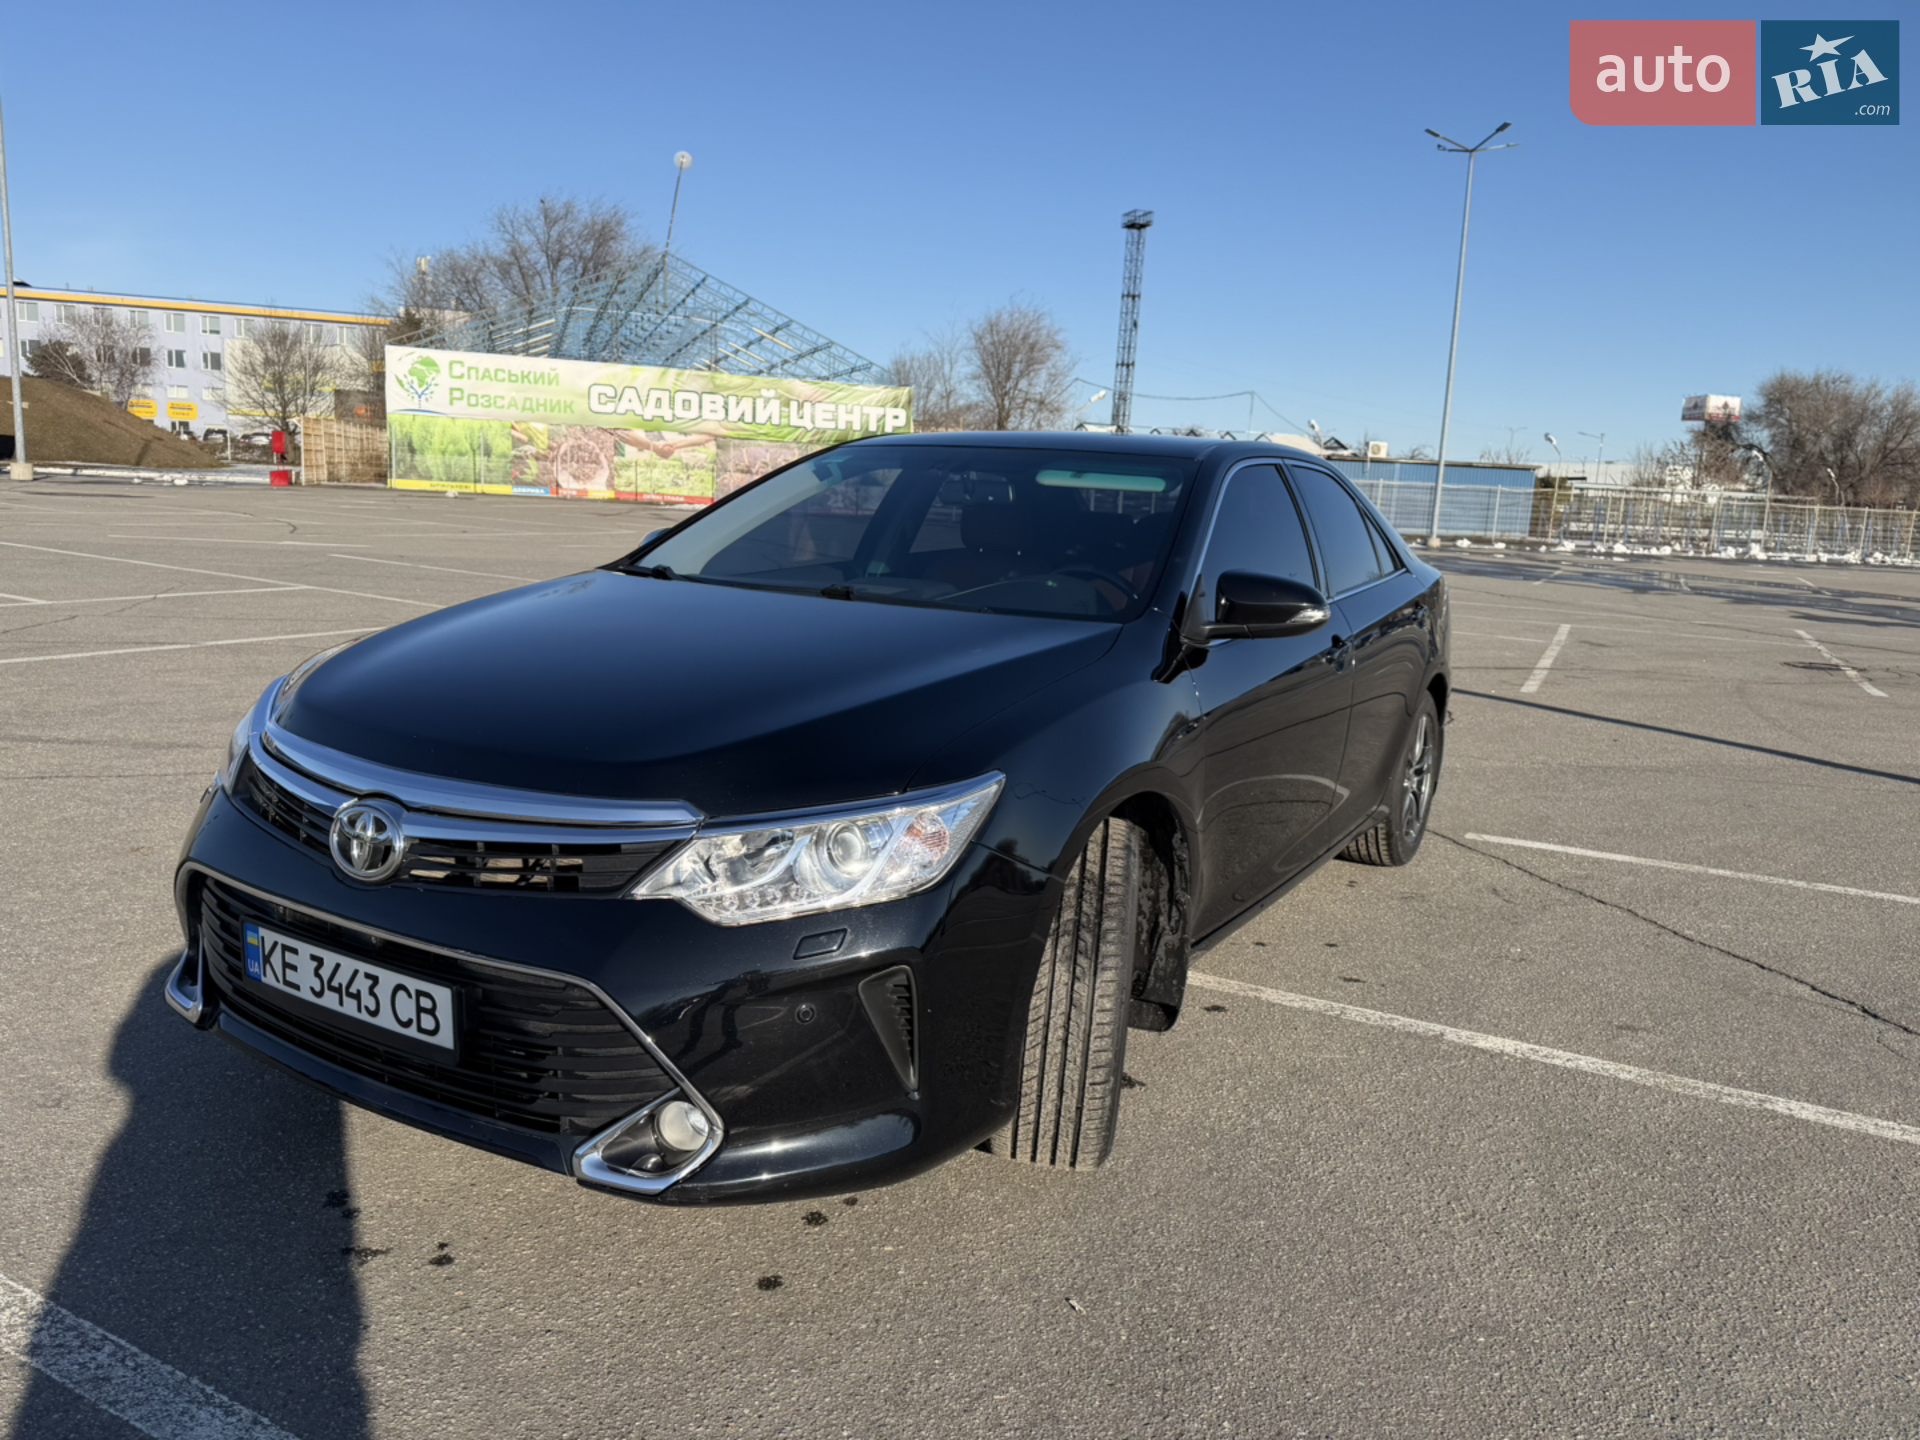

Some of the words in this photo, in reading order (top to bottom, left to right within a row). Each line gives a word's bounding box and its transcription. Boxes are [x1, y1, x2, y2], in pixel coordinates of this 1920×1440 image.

[588, 383, 781, 426] САДОВИЙ
[788, 400, 907, 433] ЦЕНТР
[247, 958, 261, 974] UA
[261, 935, 301, 992] KE
[309, 953, 381, 1018] 3443
[390, 983, 441, 1037] CB
